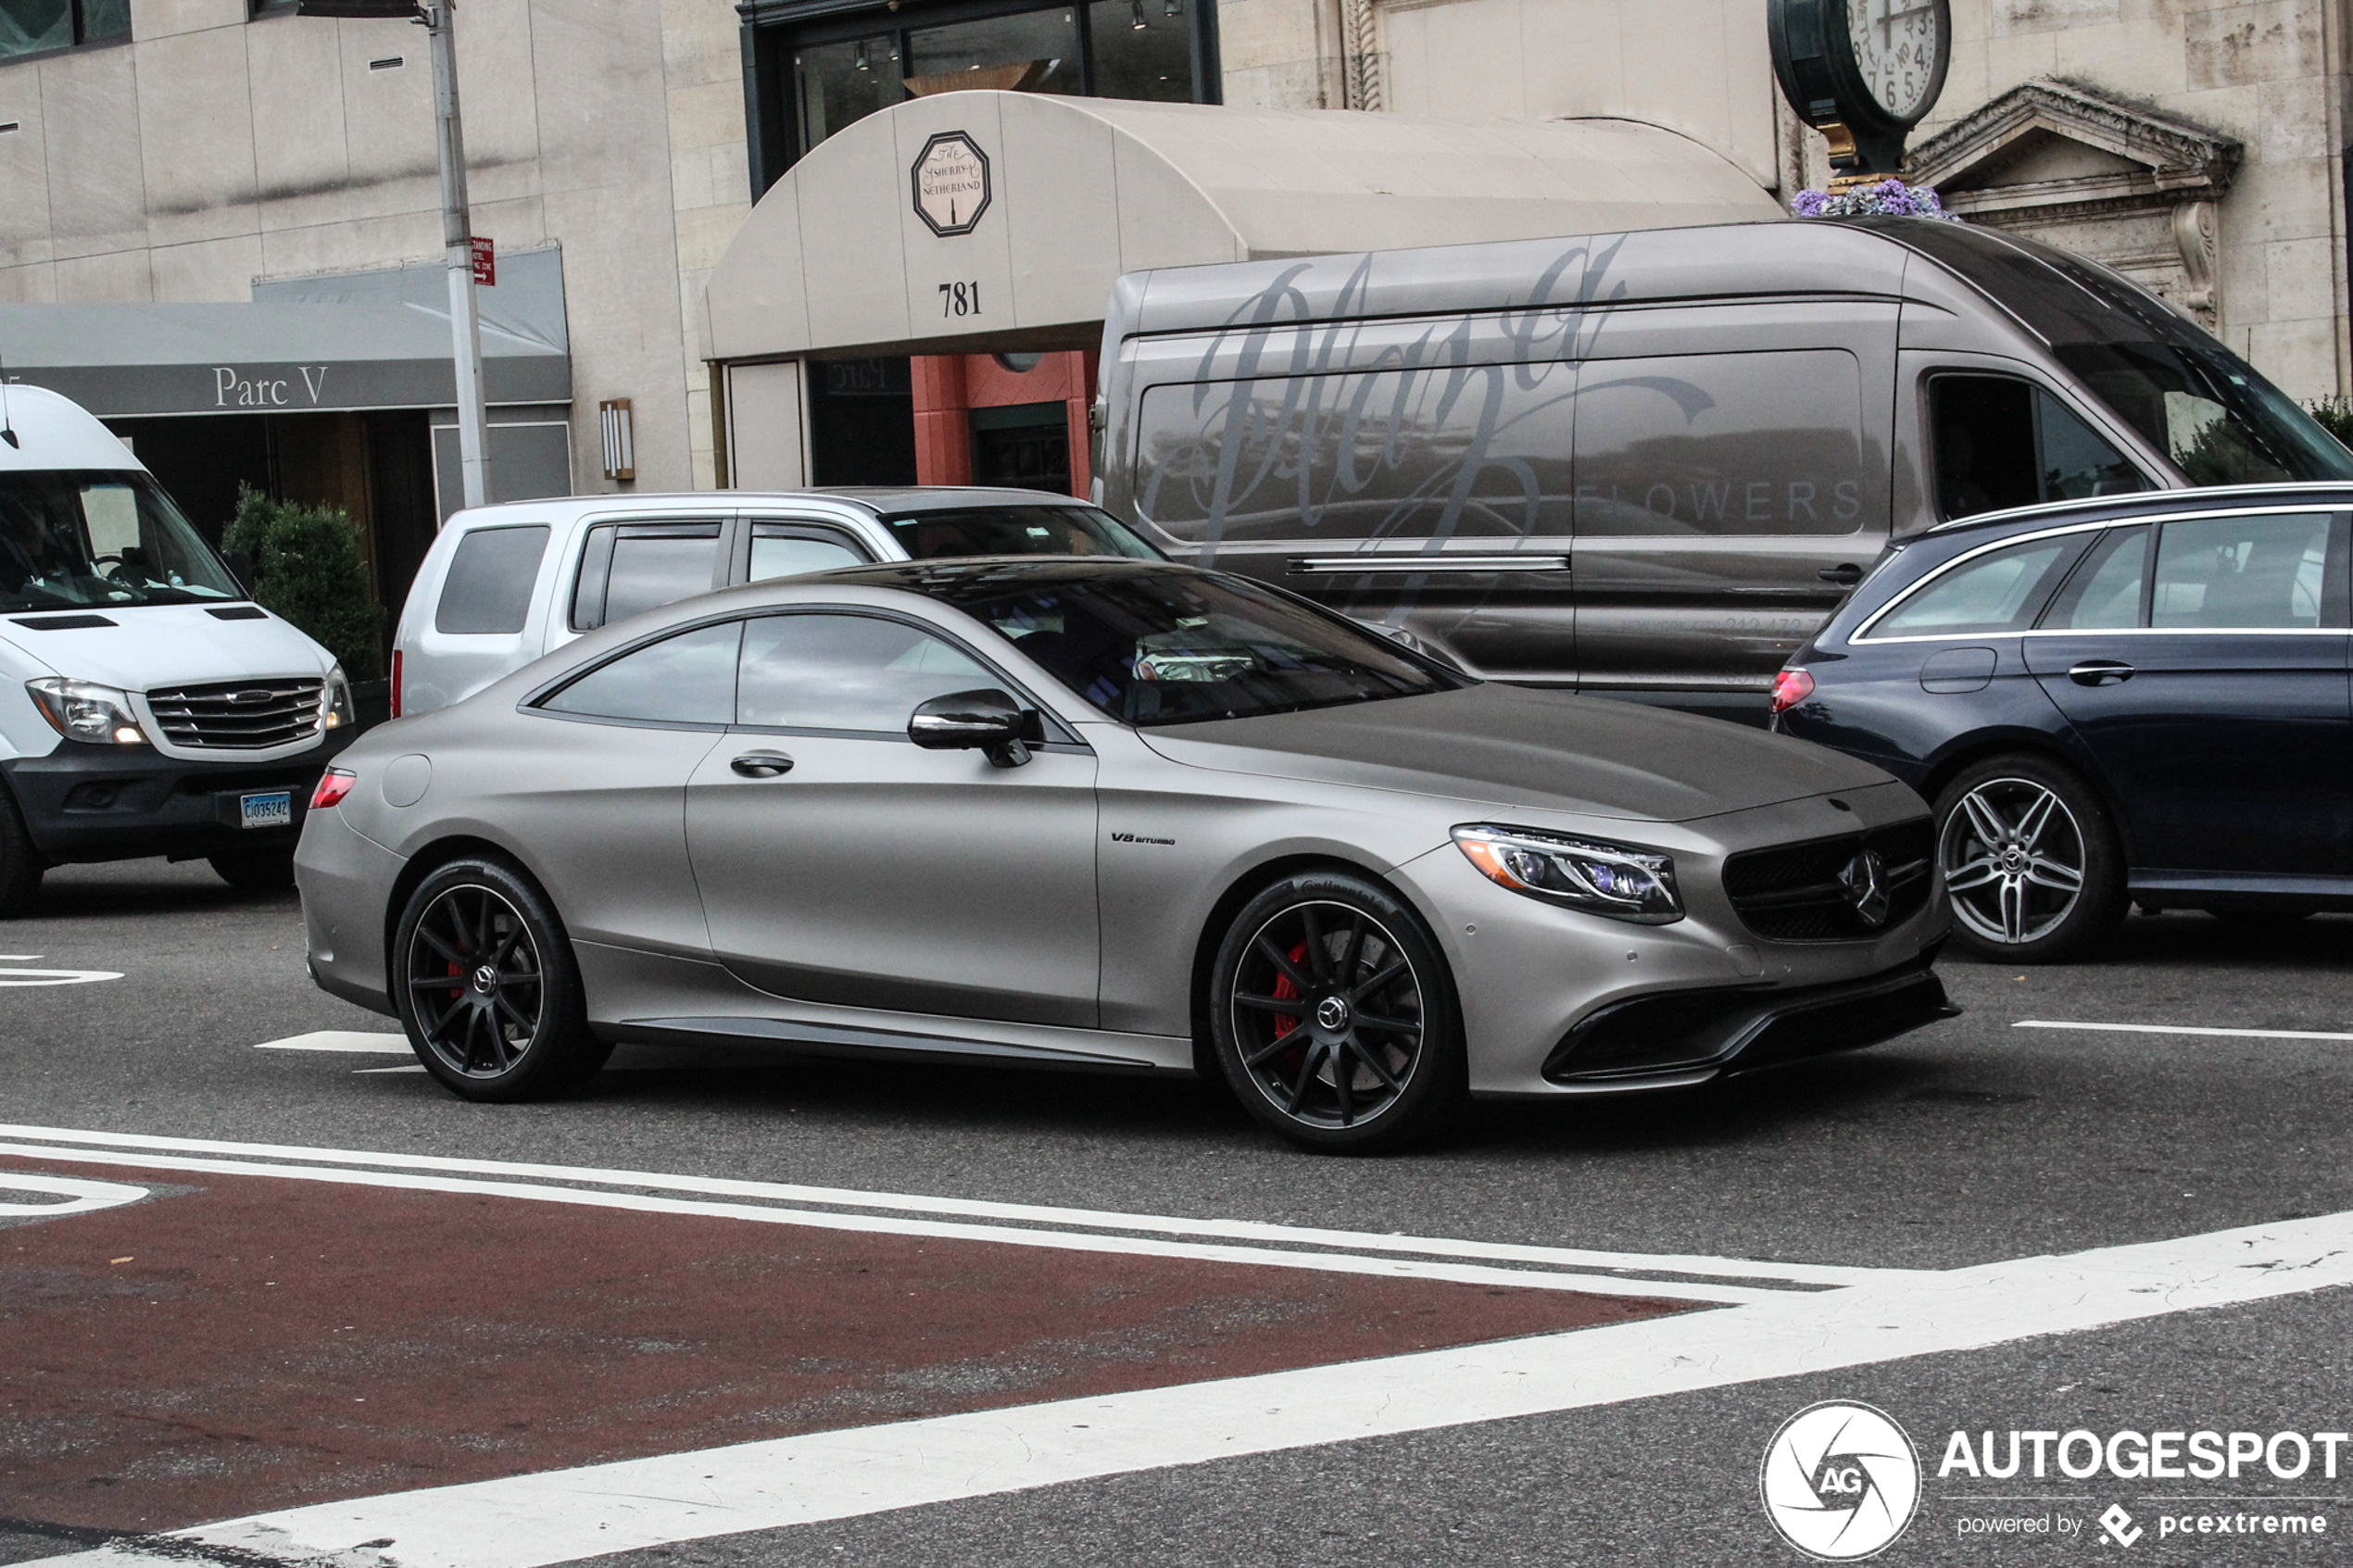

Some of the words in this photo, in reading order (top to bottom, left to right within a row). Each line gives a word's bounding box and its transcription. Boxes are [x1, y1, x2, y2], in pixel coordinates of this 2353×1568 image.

[1914, 43, 1925, 71] 4
[1886, 81, 1896, 107] 6
[1905, 71, 1914, 99] 5
[924, 181, 981, 196] NETHERLAND
[938, 280, 982, 319] 781
[212, 367, 288, 408] Parc
[298, 366, 328, 405] V
[1575, 478, 1864, 523] FLOWERS
[1112, 833, 1134, 842] V8
[1135, 837, 1176, 846] BITURBO
